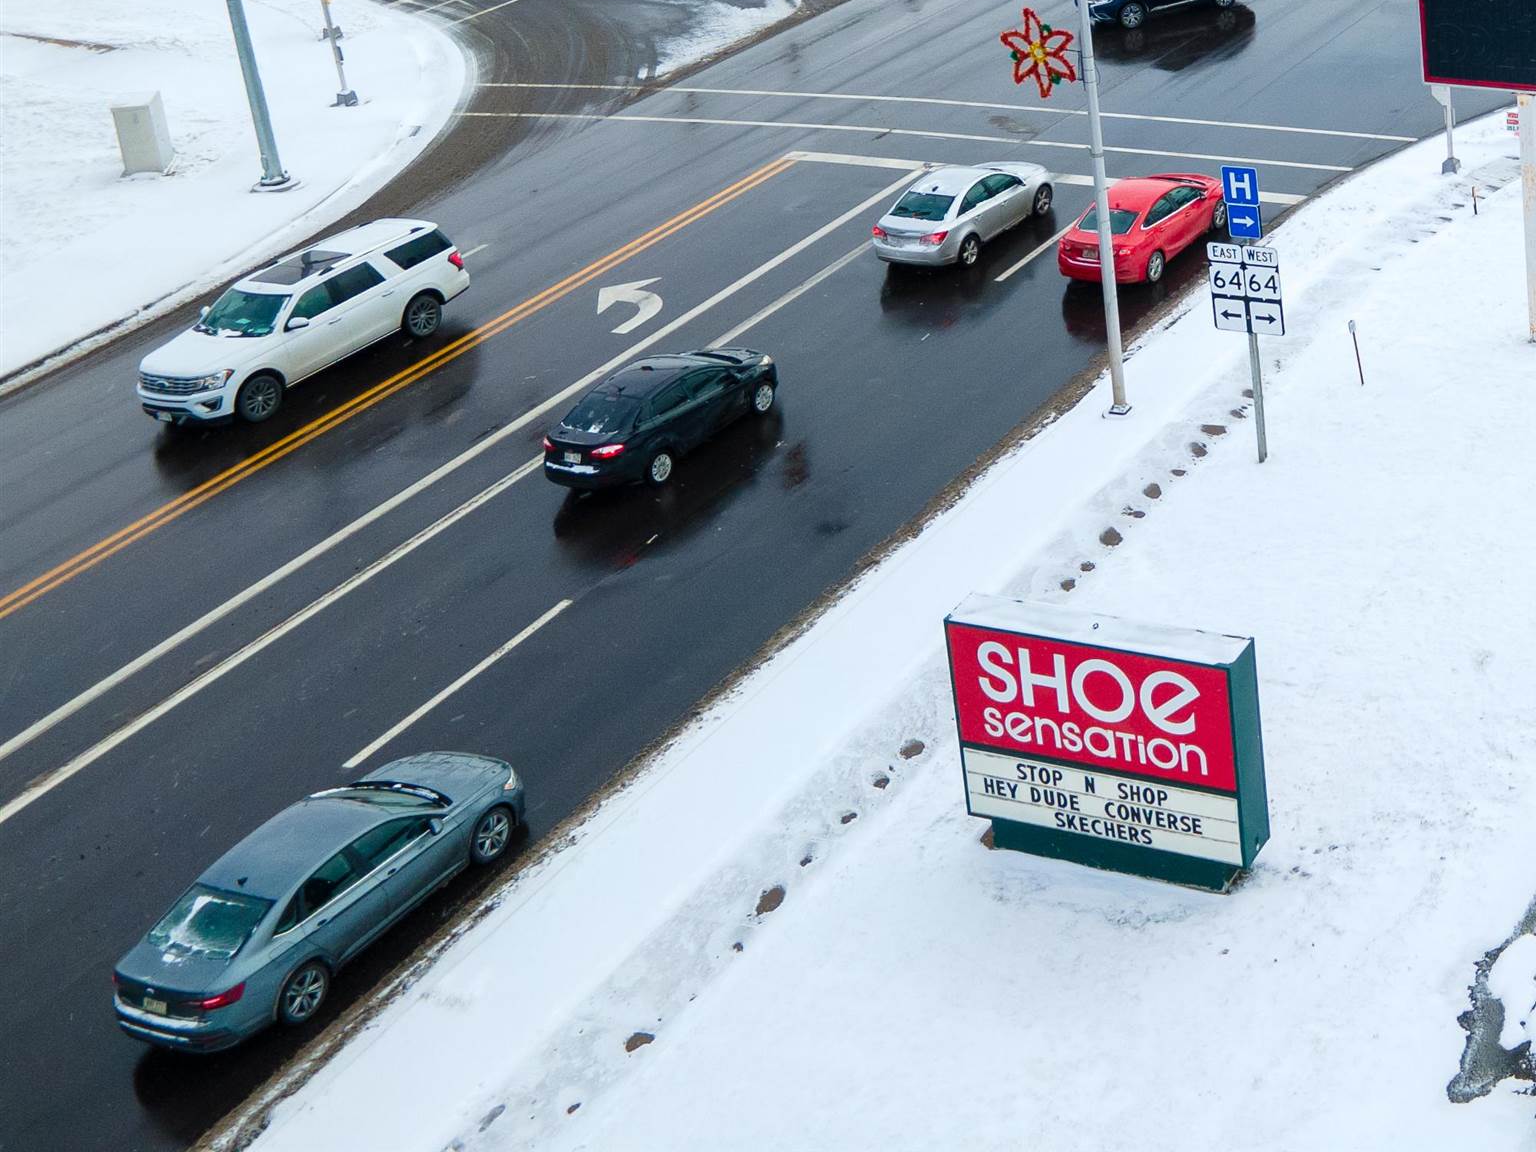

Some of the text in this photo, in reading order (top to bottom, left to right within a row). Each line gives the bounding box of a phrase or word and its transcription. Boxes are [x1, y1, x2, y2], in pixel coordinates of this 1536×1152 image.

[1229, 172, 1251, 200] H
[1212, 245, 1238, 259] EAST
[1246, 249, 1273, 263] WEST
[1213, 270, 1242, 291] 64
[1249, 274, 1278, 294] 64
[1016, 763, 1168, 807] STOP N SHOP
[983, 777, 1204, 836] HEY DUDE CONVERSE
[1054, 812, 1154, 846] SKECHERS
